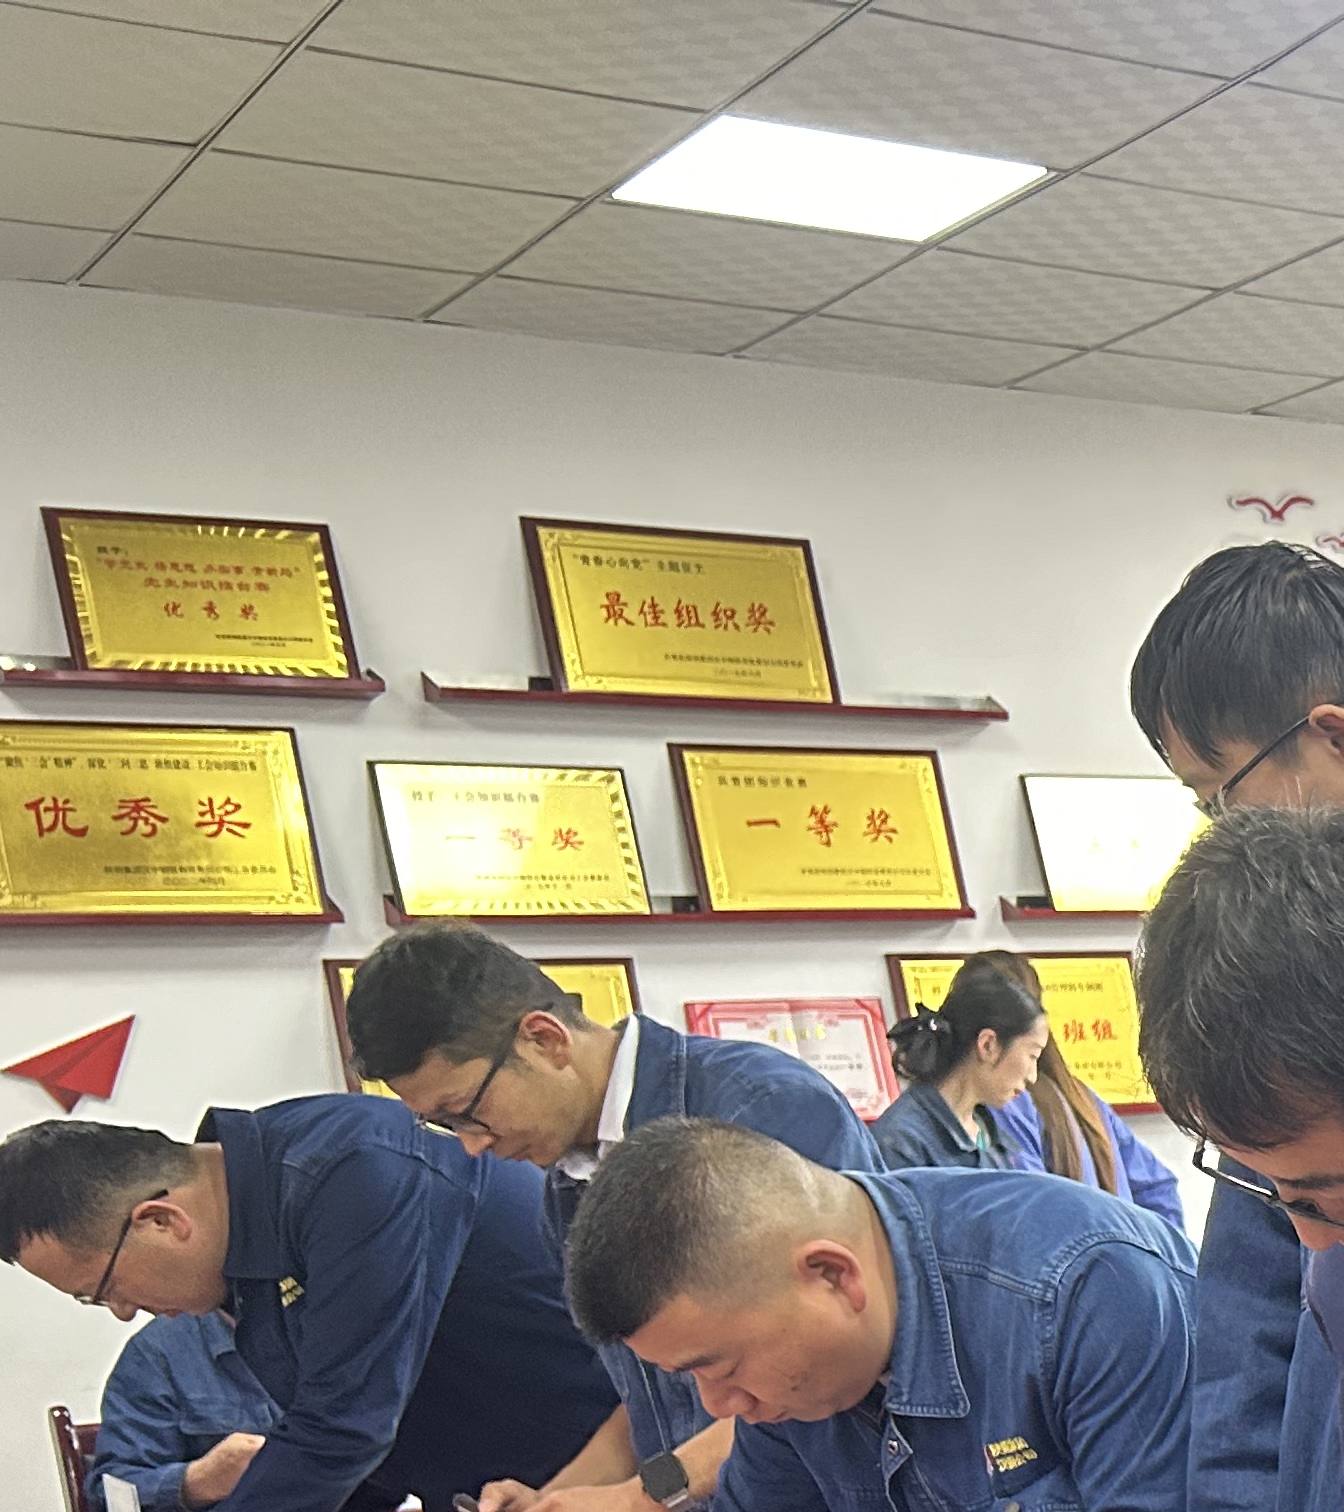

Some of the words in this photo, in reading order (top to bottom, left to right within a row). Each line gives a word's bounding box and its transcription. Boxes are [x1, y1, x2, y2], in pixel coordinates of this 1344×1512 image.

[600, 591, 776, 635] 最佳组织奖
[24, 796, 252, 838] 优秀奖
[746, 804, 899, 847] 一等奖
